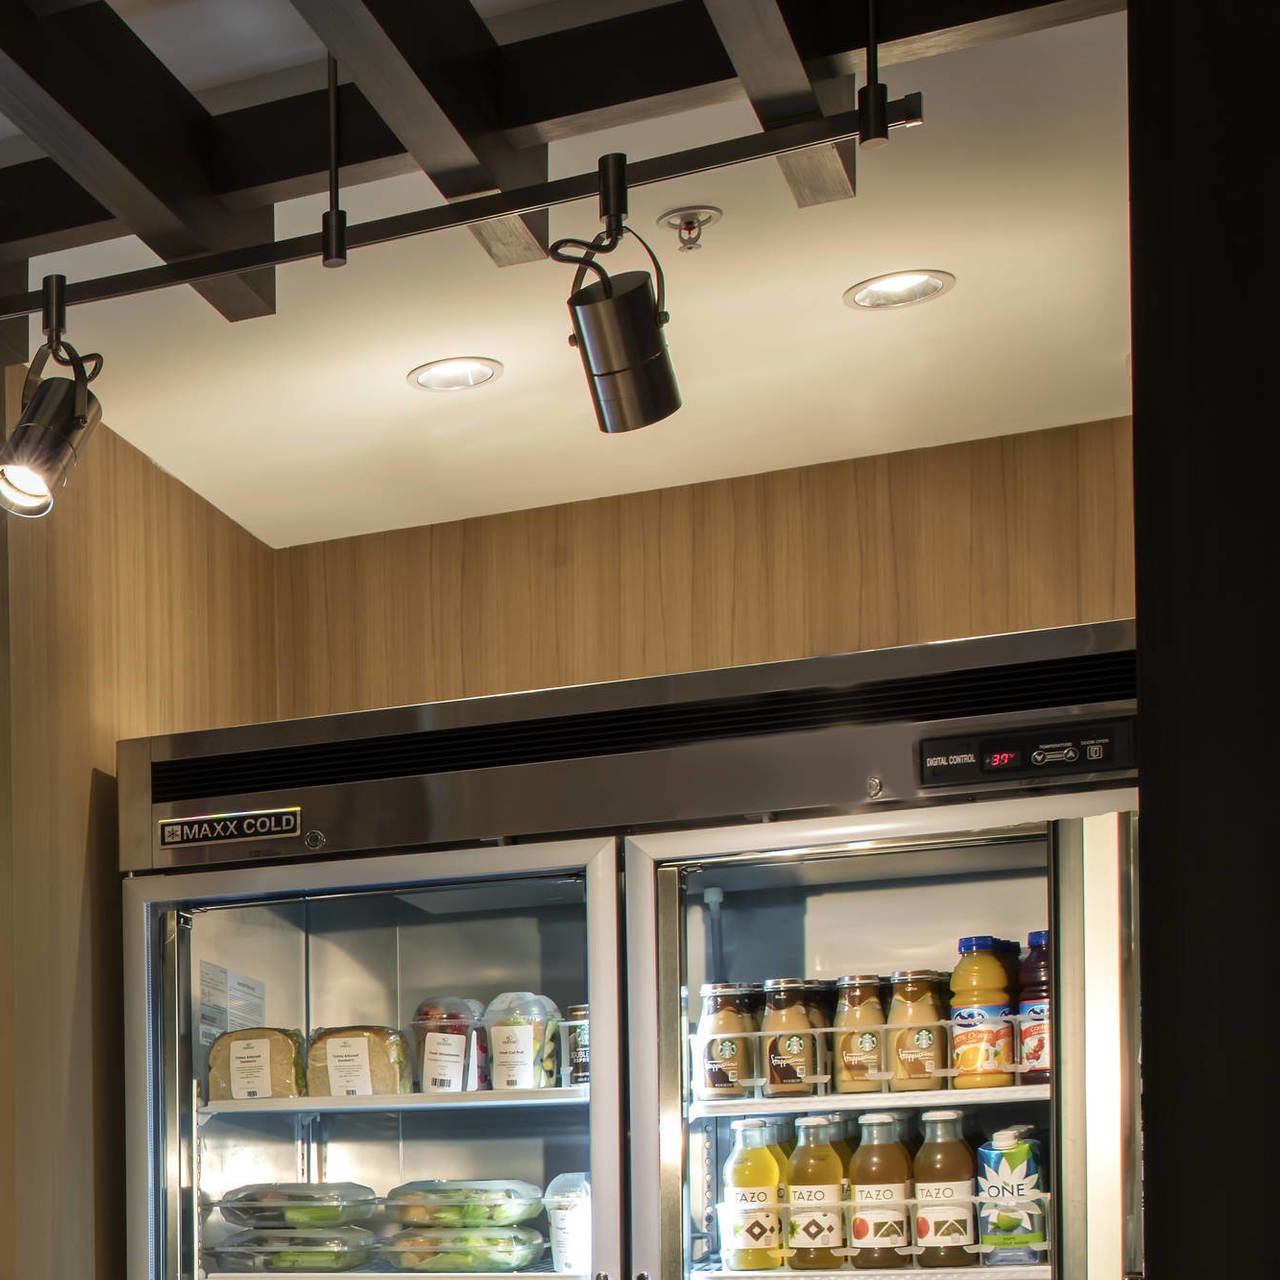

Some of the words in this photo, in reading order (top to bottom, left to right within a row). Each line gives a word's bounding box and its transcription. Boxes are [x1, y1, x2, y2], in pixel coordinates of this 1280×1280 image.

[926, 756, 949, 767] DIGITAL
[949, 753, 976, 766] CONTROL
[183, 820, 239, 840] MAXX
[243, 814, 295, 834] COLD
[791, 1189, 825, 1202] TAZO
[857, 1188, 894, 1201] TAZO
[919, 1187, 954, 1200] TAZO
[987, 1183, 1026, 1198] ONE
